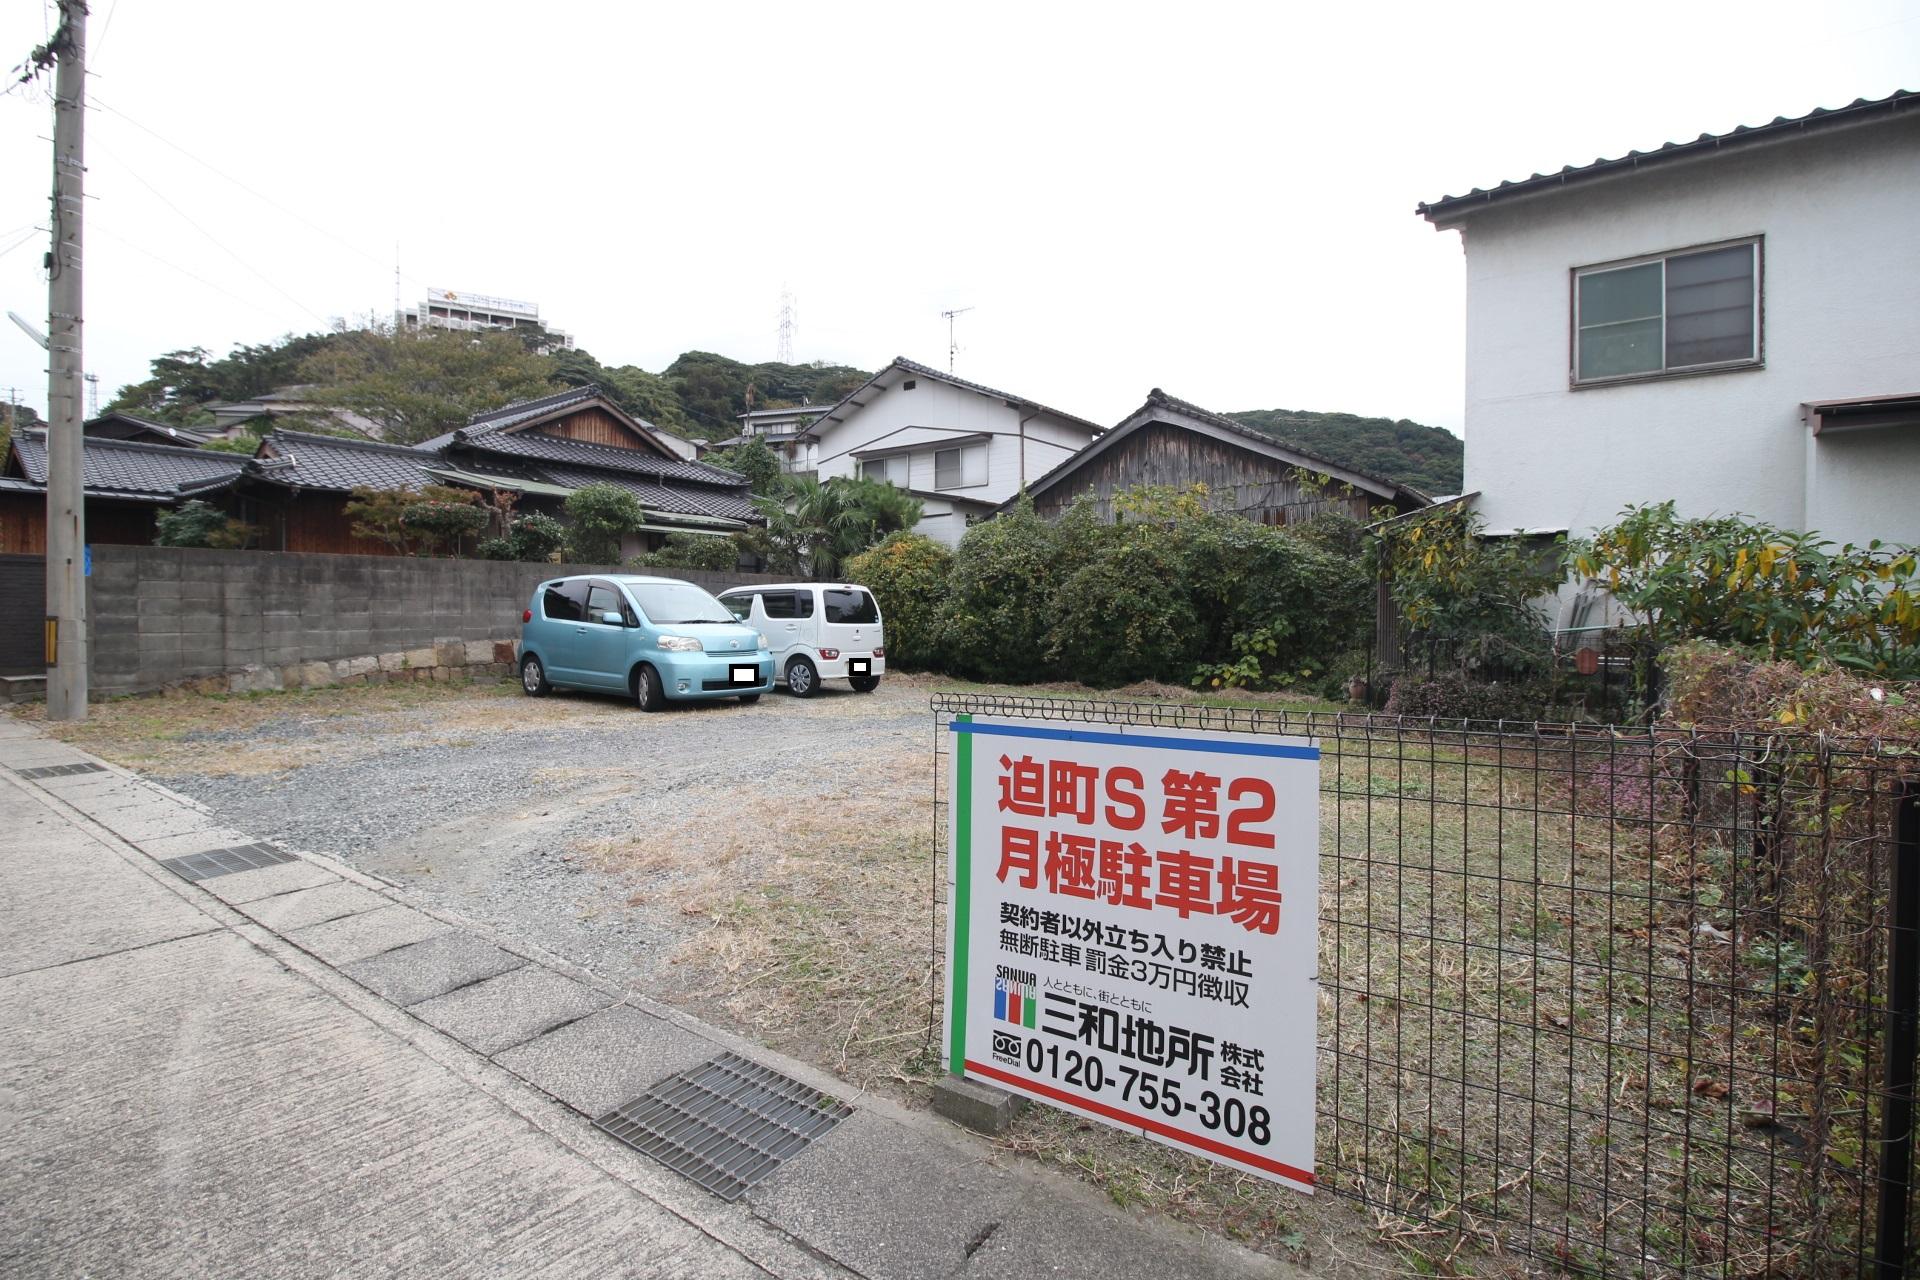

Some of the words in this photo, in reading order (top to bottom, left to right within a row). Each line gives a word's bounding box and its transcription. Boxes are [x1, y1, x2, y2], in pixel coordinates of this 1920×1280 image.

[998, 753, 1146, 831] 迫町S
[1161, 769, 1276, 850] 第2
[996, 826, 1282, 936] 月極駐車場
[996, 964, 1037, 987] SANWA
[1000, 901, 1253, 978] 契約者以外立ち入り禁止
[1042, 991, 1215, 1081] 三和地所
[1026, 1038, 1272, 1146] 0120-755-308
